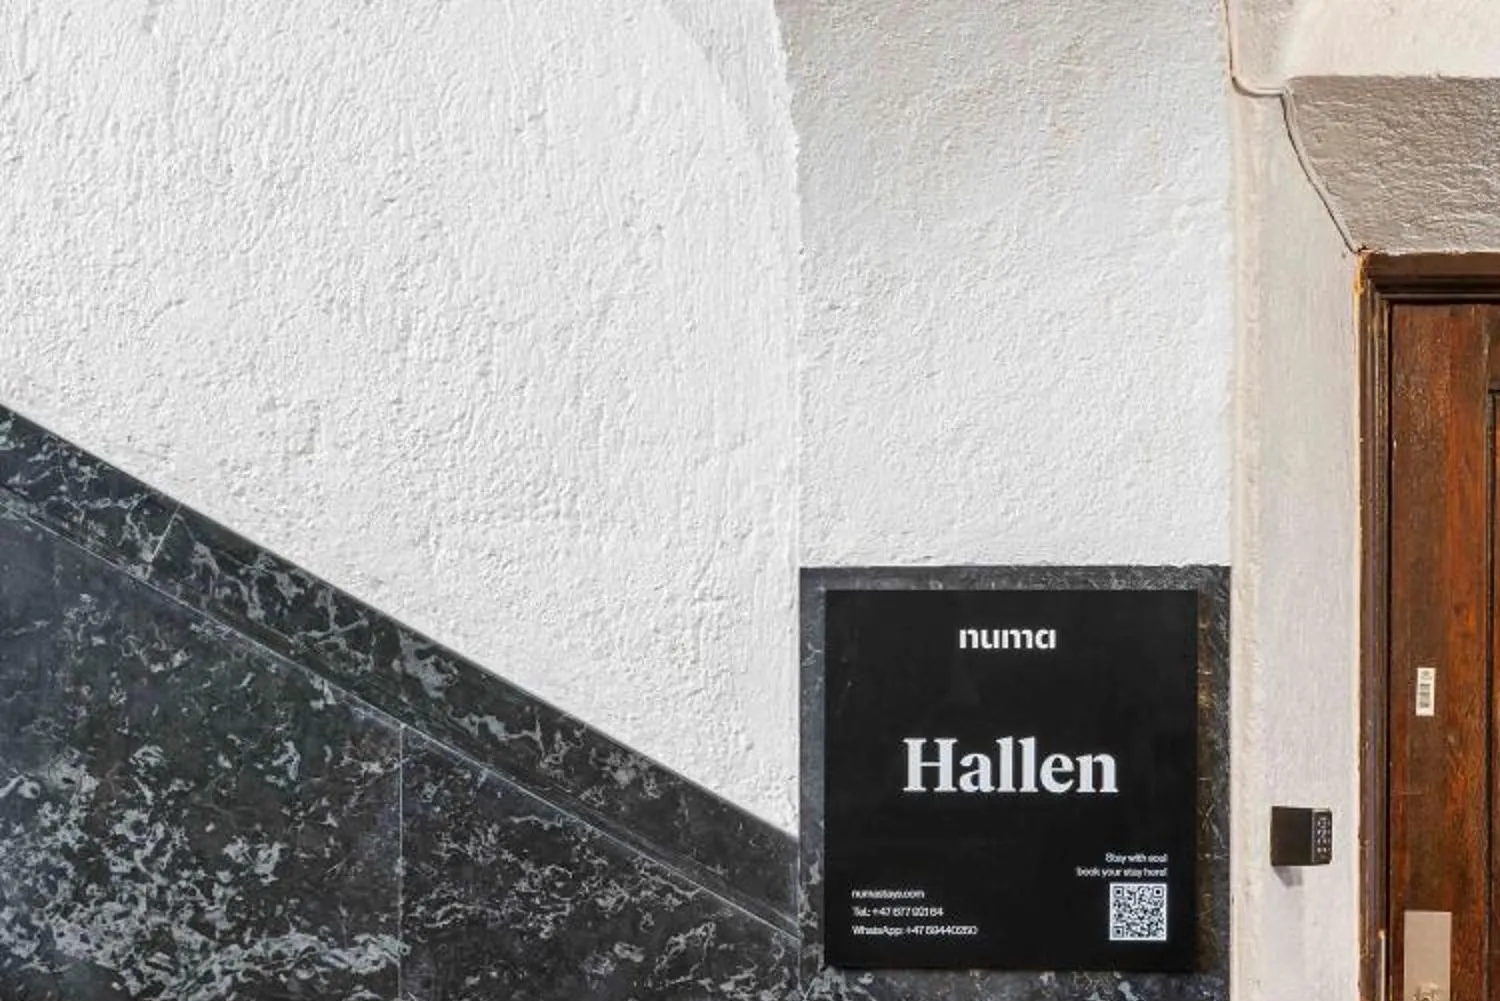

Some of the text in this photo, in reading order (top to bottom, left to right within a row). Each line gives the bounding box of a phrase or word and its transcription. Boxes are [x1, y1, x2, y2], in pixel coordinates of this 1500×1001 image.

[959, 628, 1056, 649] numa
[903, 736, 1119, 793] Hallen
[1127, 853, 1146, 862] with
[1101, 868, 1122, 878] your
